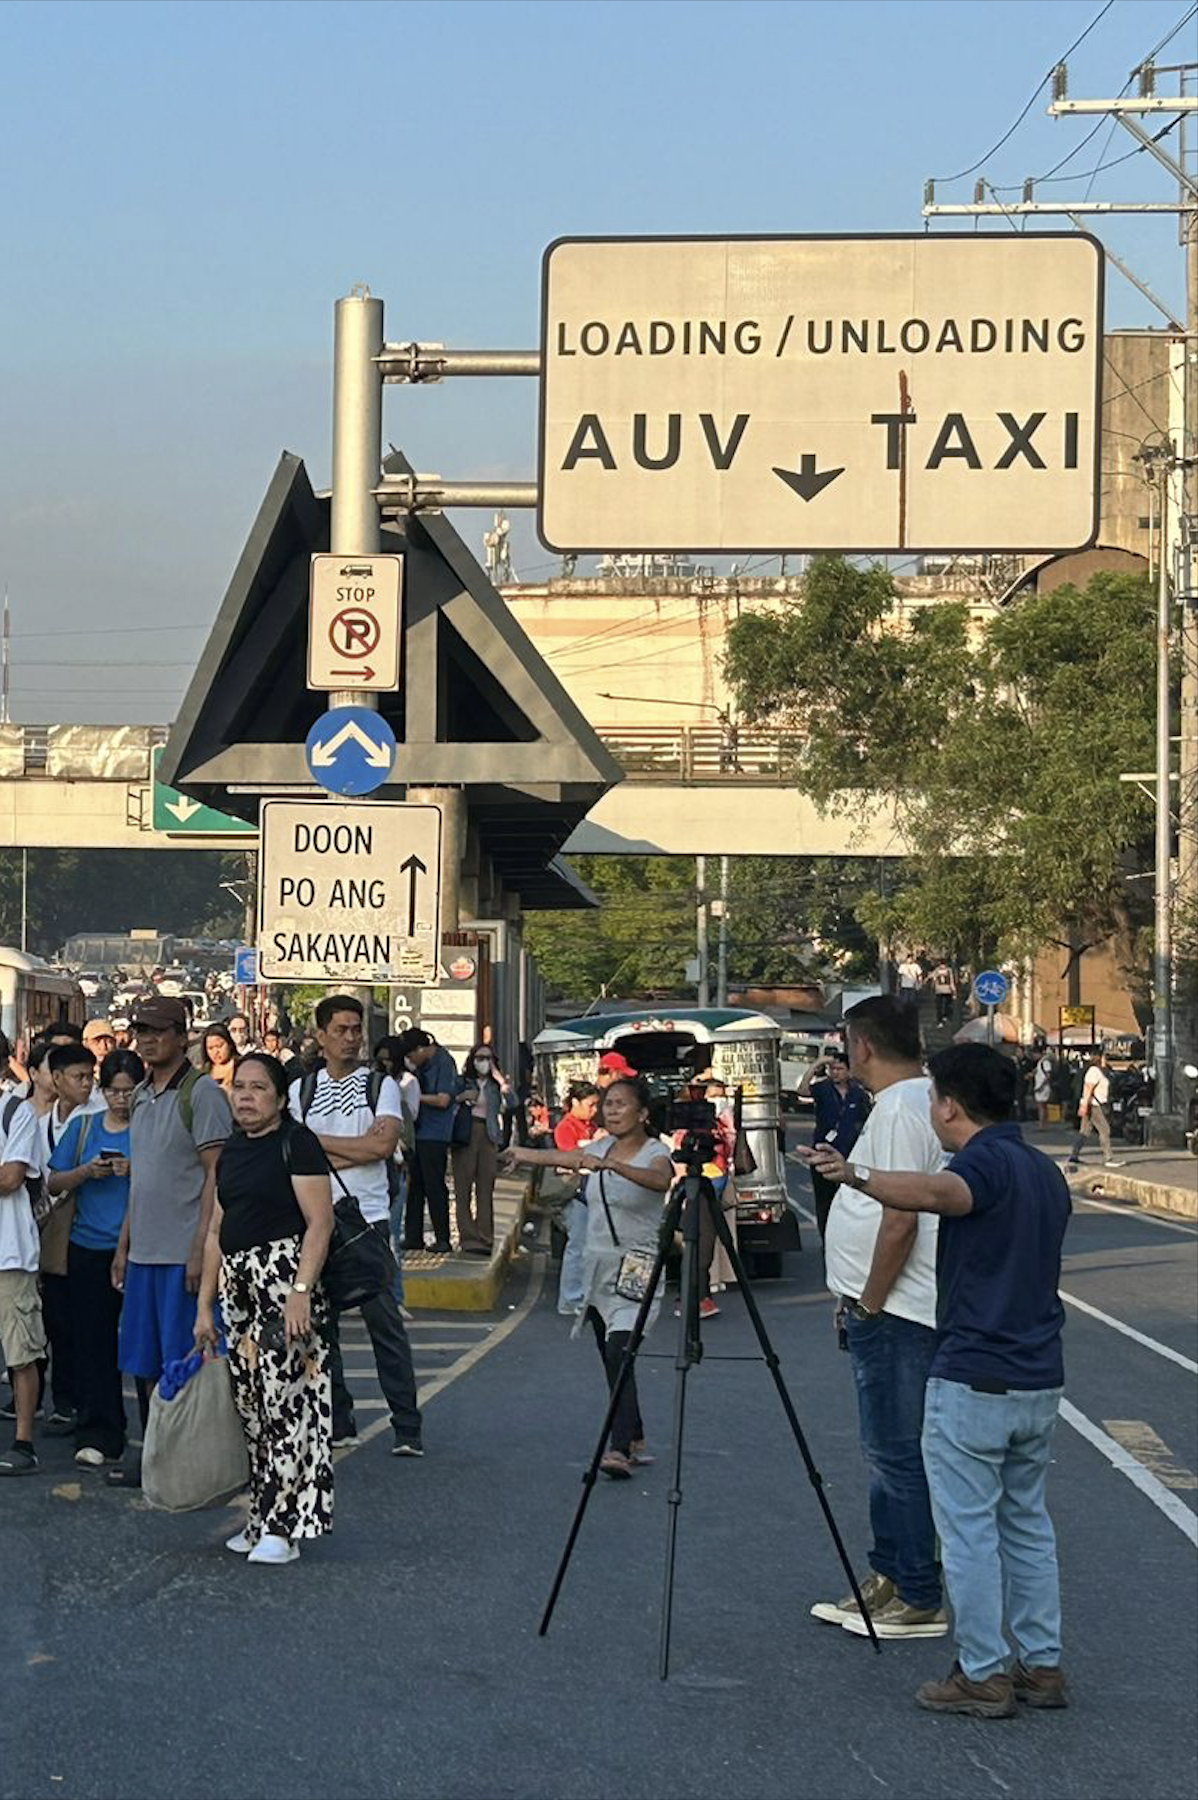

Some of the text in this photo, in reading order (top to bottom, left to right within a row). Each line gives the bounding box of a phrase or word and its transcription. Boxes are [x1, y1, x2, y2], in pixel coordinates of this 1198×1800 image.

[558, 320, 762, 356] LOADING
[808, 318, 1086, 355] UNLOADING
[560, 411, 1079, 471] AUV TAXI
[336, 587, 375, 602] STOP
[295, 824, 372, 855] DOON
[280, 877, 386, 909] PO ANG
[273, 932, 391, 964] SAKAYAN
